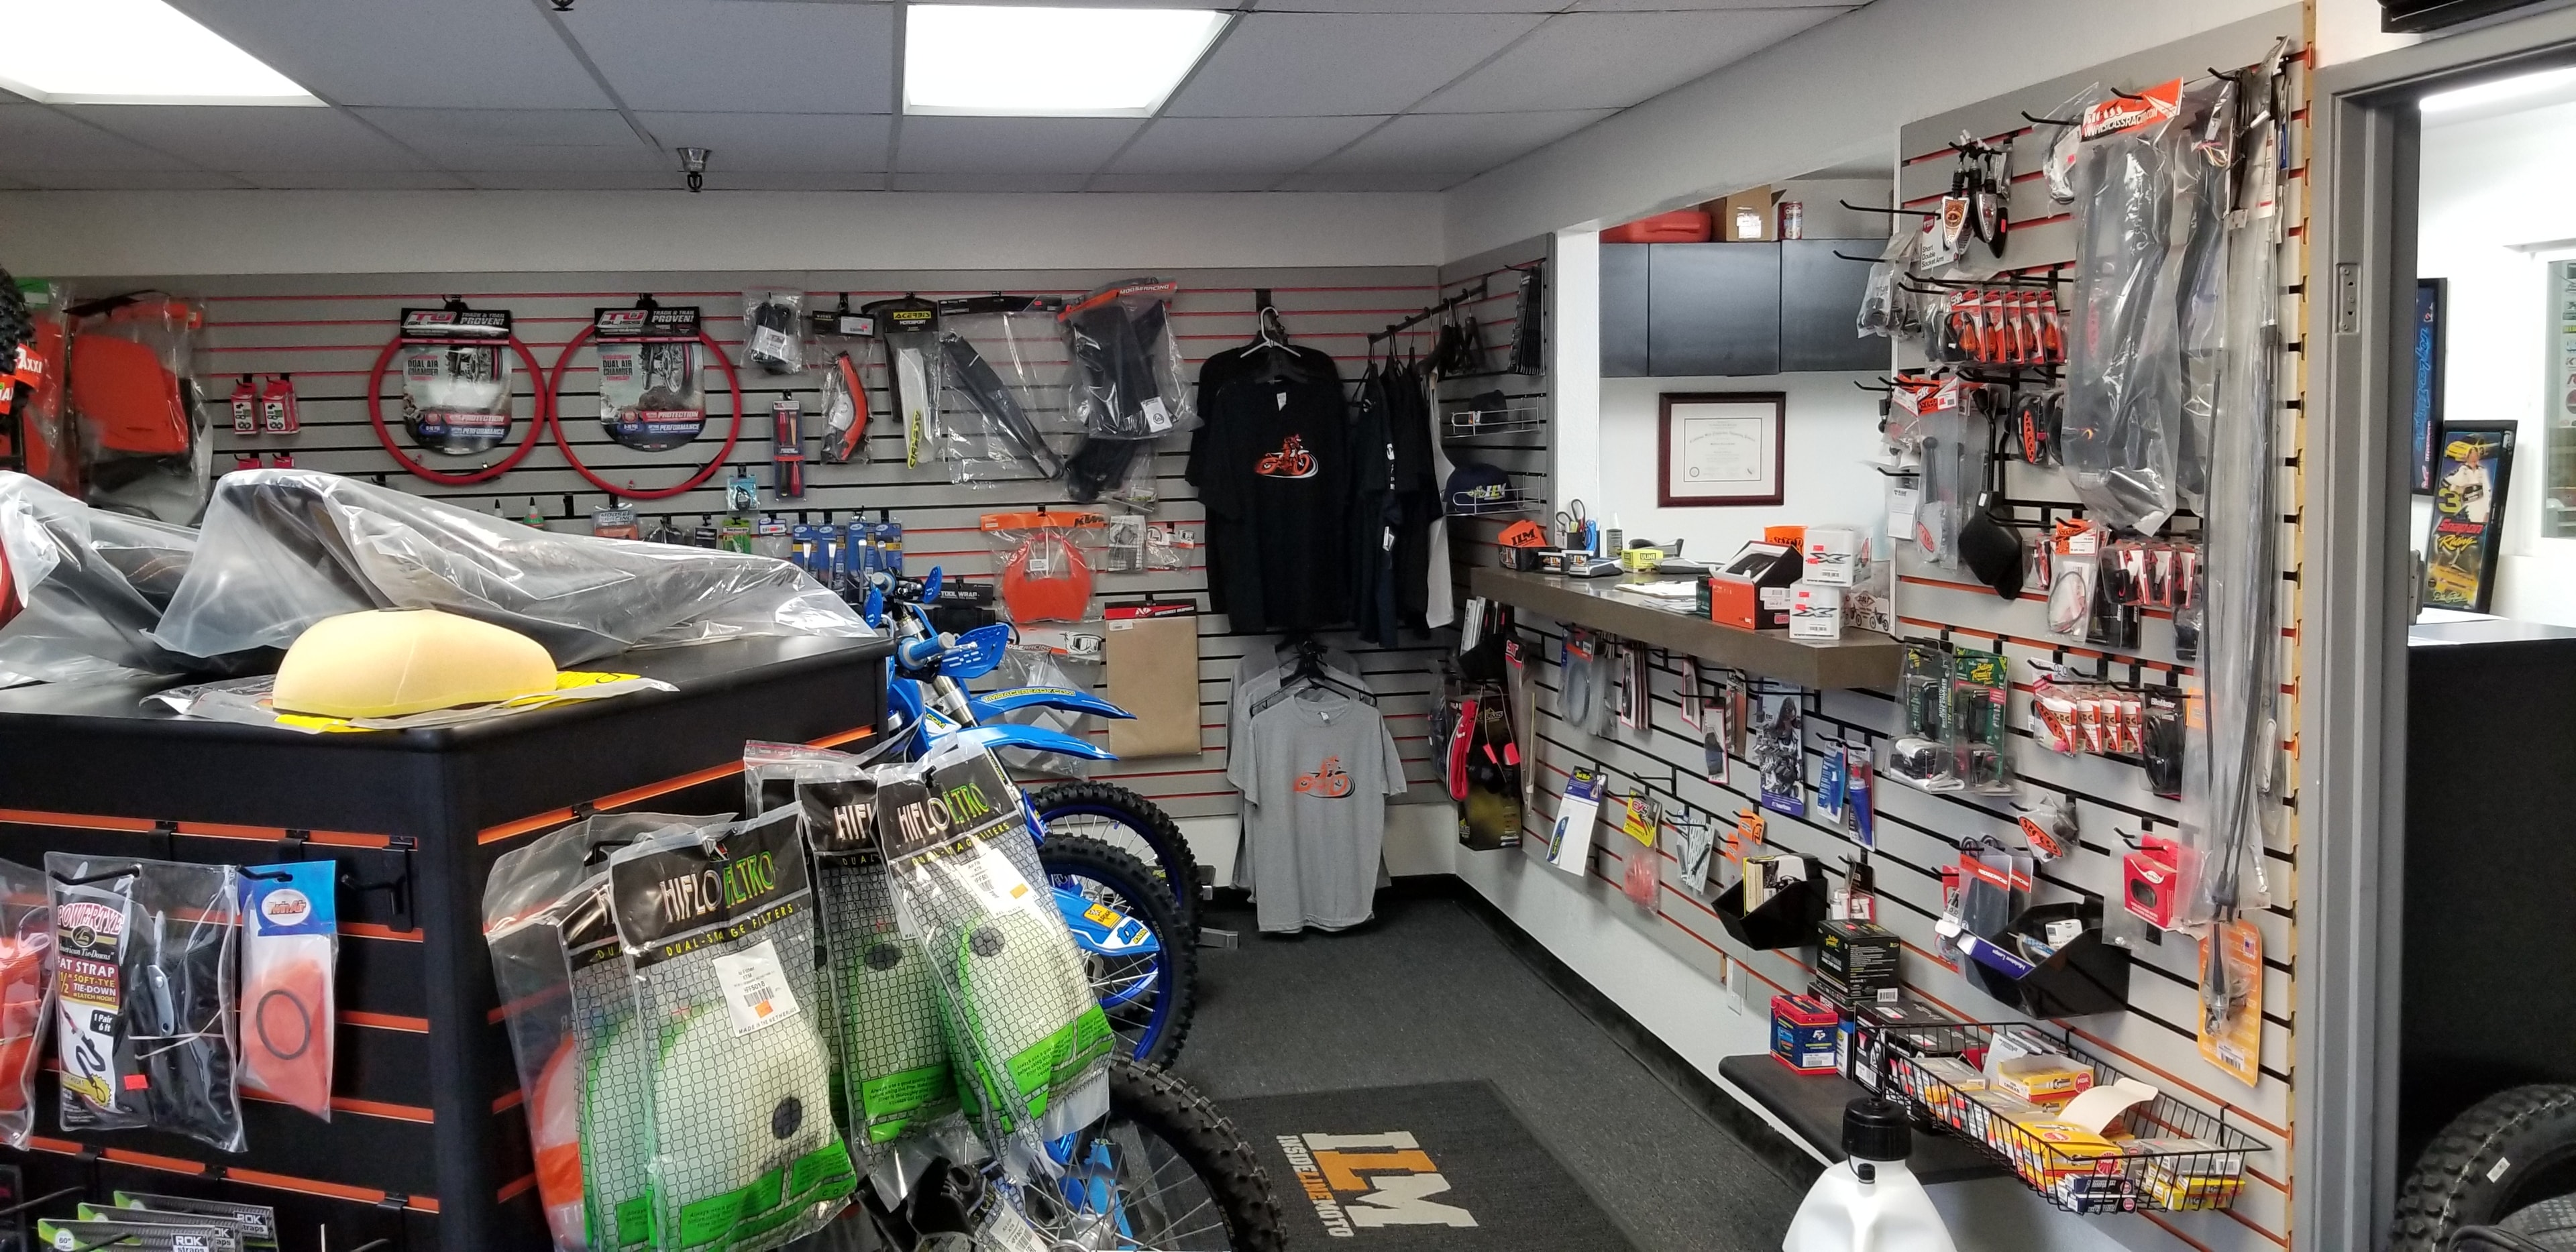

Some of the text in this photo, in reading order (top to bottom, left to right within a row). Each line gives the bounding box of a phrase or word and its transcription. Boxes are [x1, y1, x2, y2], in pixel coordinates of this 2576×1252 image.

[651, 315, 694, 323] PROVEN!
[602, 359, 633, 368] DUAL AIR
[657, 411, 699, 419] PROTECTION
[659, 423, 700, 432] PERFORMANCE
[1511, 528, 1535, 546] ILM
[1640, 553, 1657, 561] ULINE
[983, 688, 1076, 703] TMRACEREADY.COM
[834, 803, 871, 841] HIF
[897, 797, 950, 844] HIFLO
[659, 870, 722, 923] HIFLO
[57, 903, 125, 935] POWERTYE
[751, 903, 794, 929] FILTERS
[58, 944, 80, 956] merican
[75, 961, 115, 978] STRAP
[74, 974, 116, 988] SOFT-TYE
[73, 983, 117, 997] TIE-DOWN
[94, 1013, 113, 1023] 1 Pair
[99, 1023, 111, 1032] 6 ft
[738, 1025, 755, 1035] MADE
[1302, 1131, 1479, 1227] ILM
[237, 1213, 262, 1225] ROK
[242, 1225, 264, 1233] traps
[175, 1235, 203, 1246] ROK
